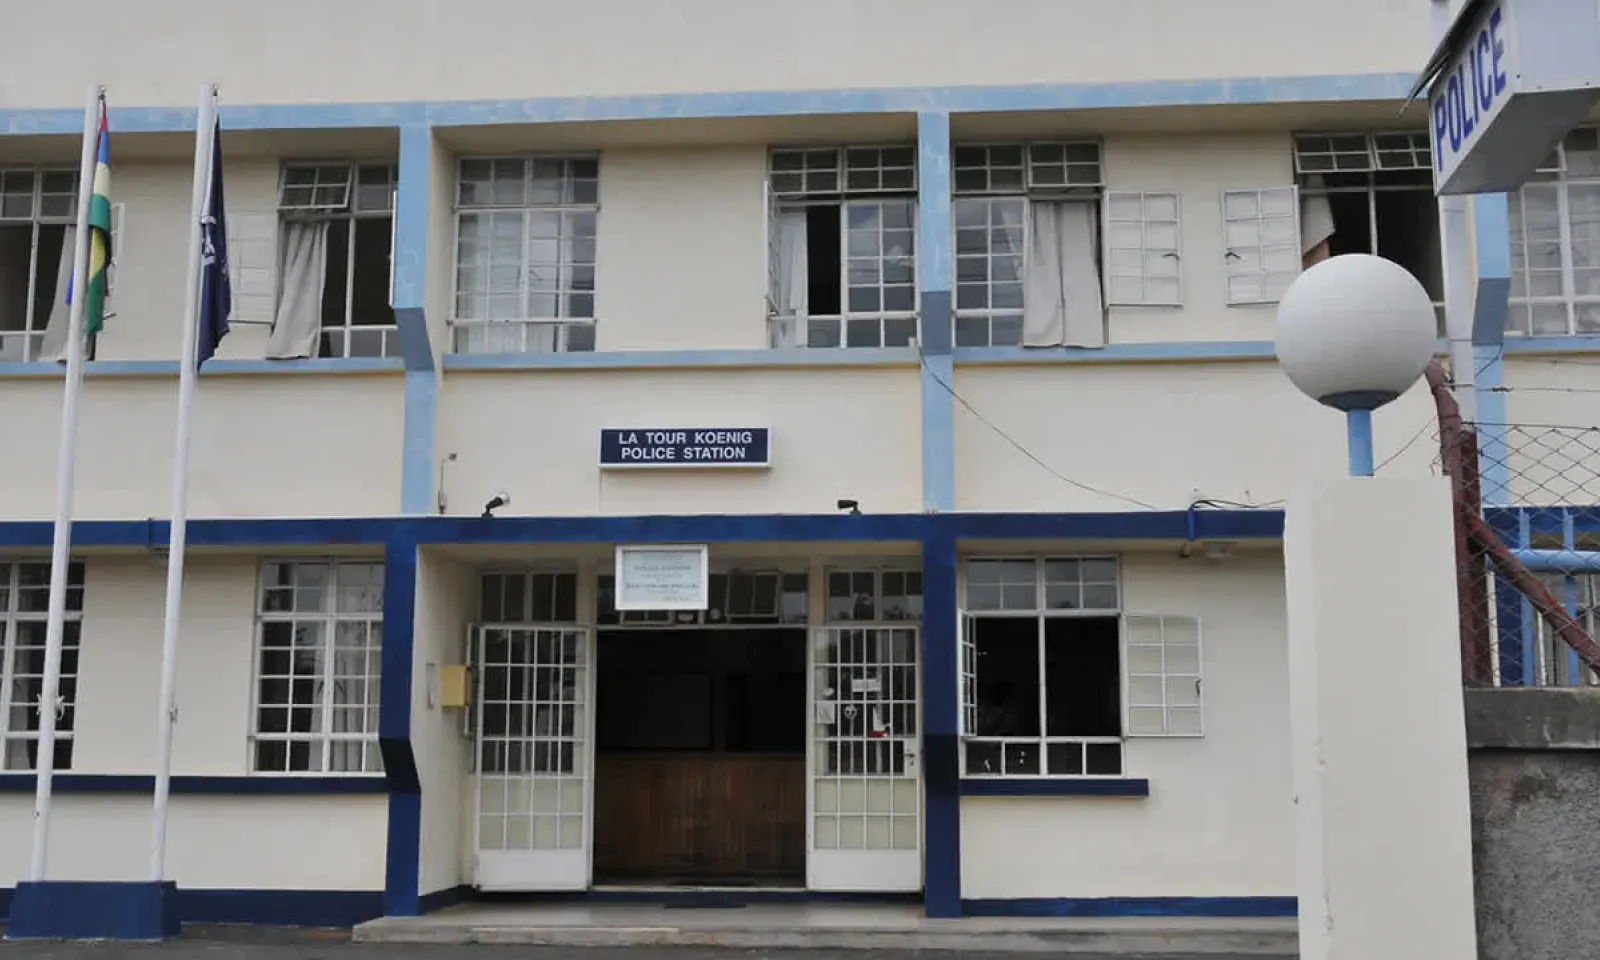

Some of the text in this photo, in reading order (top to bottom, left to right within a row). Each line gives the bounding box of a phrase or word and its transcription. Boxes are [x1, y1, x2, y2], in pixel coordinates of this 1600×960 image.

[1434, 6, 1506, 173] POLICE
[619, 431, 753, 445] LA TOUR KOENIG
[621, 447, 746, 459] POLICE STATION
